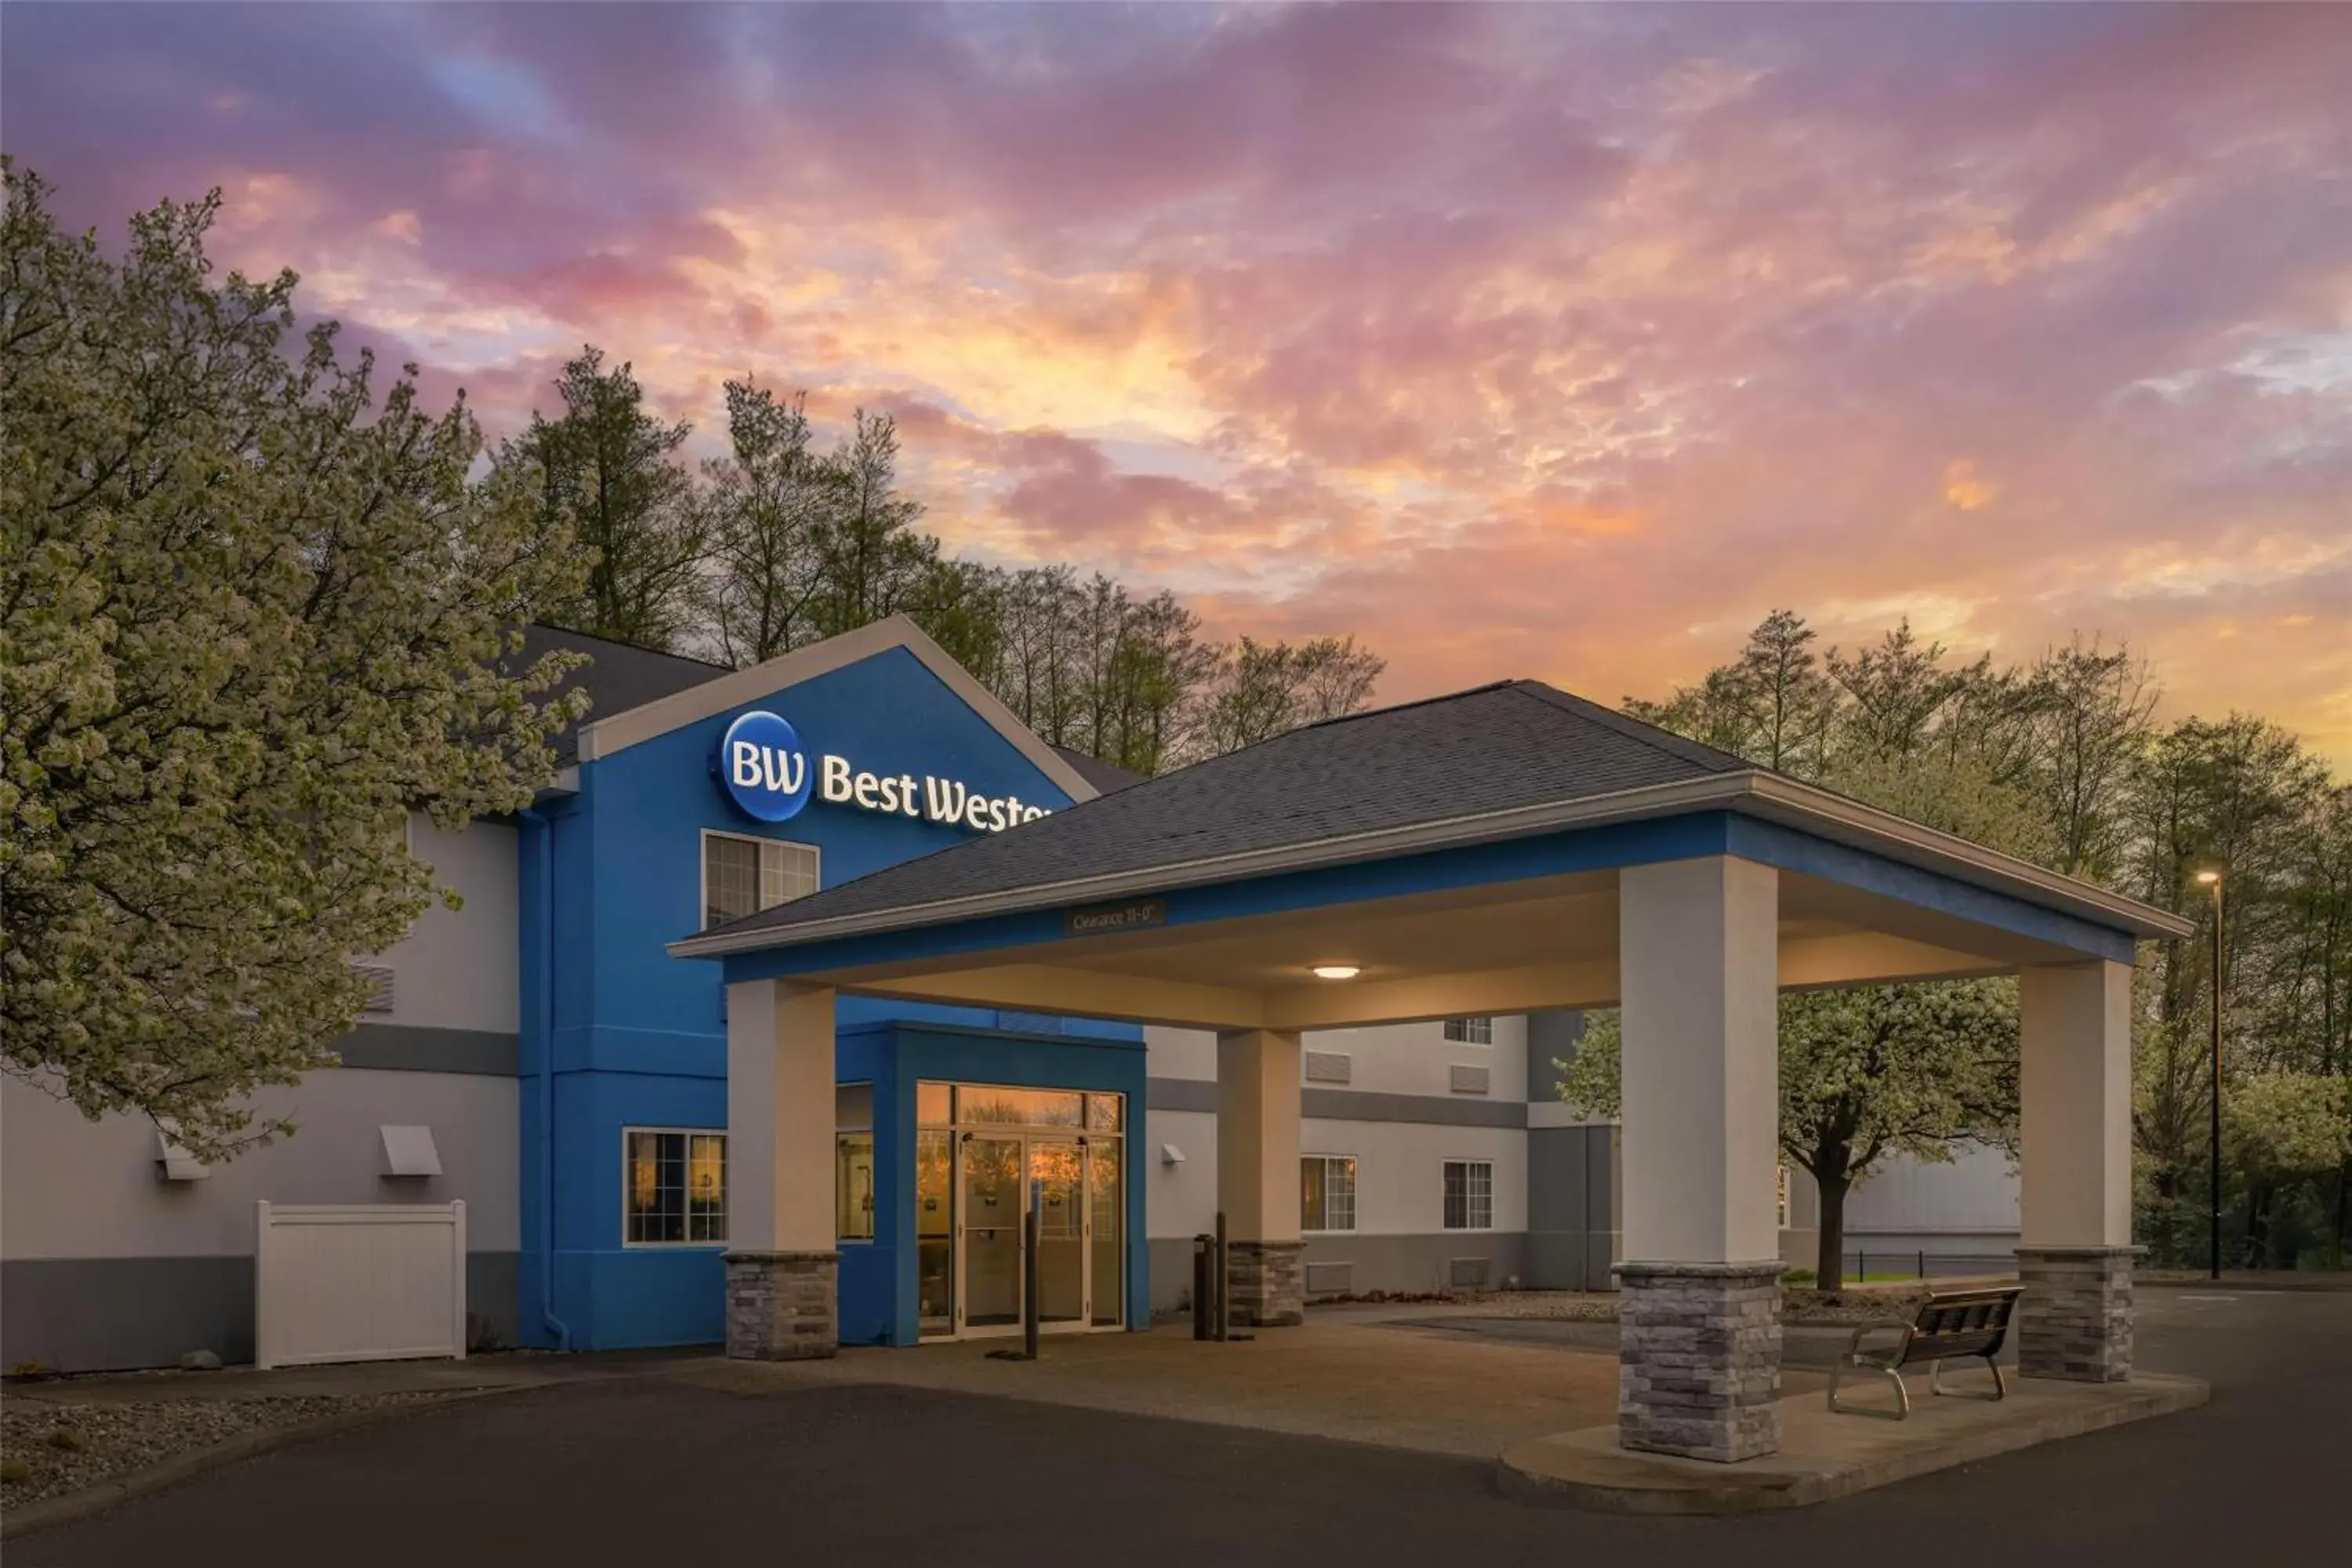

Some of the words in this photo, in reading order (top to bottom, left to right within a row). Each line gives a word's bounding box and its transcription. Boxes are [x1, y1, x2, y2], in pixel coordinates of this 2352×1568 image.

[733, 741, 804, 795] BW
[822, 754, 920, 817] Best
[926, 775, 1052, 832] West
